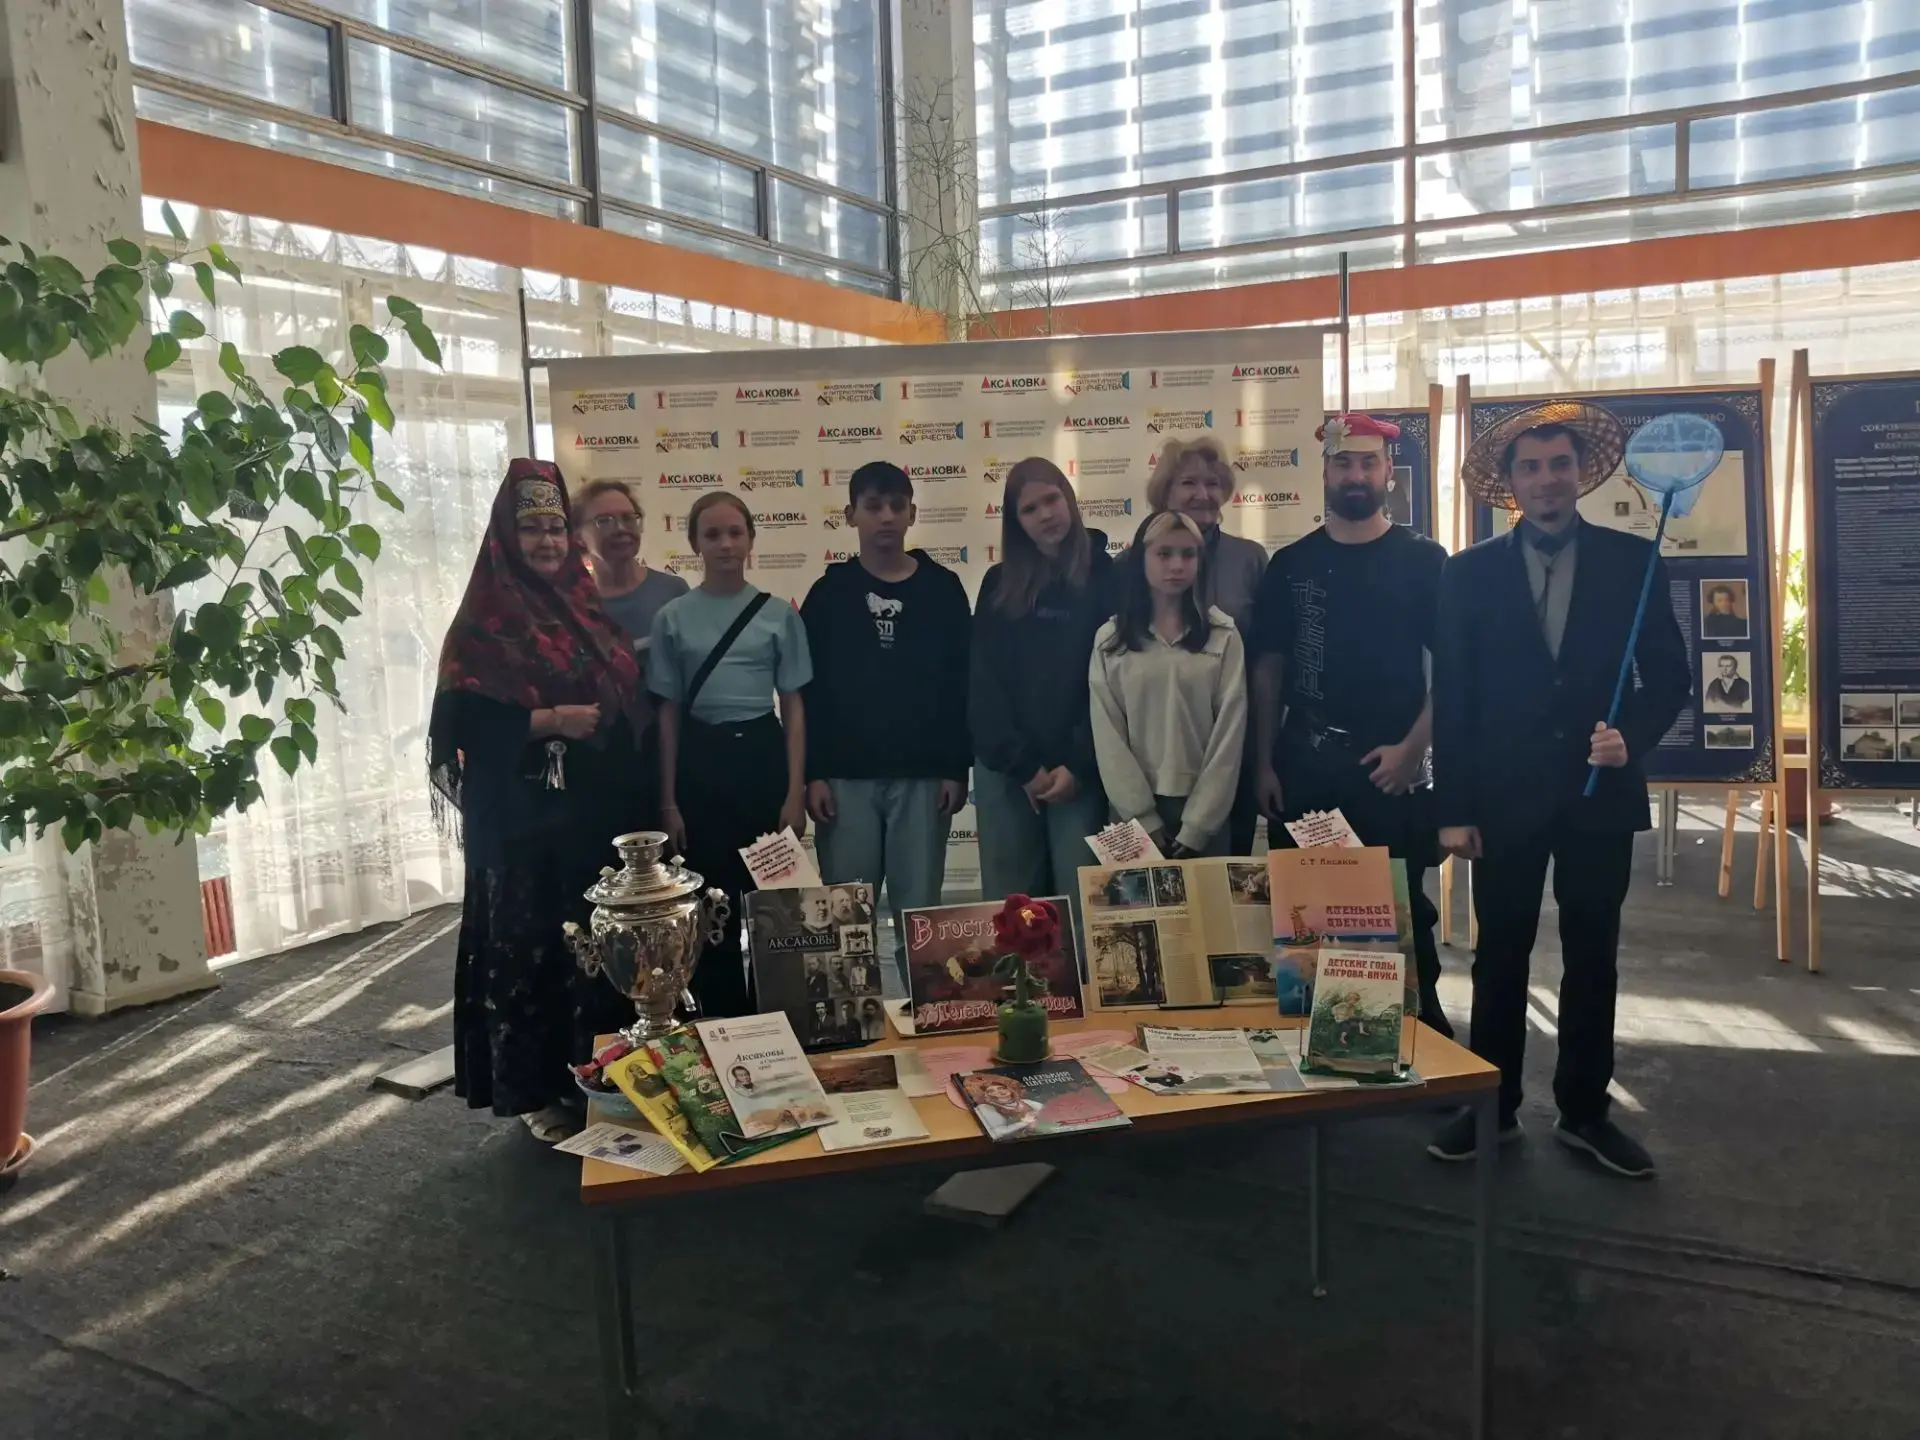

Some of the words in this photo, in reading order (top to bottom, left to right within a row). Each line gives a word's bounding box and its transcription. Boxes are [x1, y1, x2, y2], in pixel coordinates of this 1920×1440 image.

[752, 512, 807, 523] КСАКОВКА
[911, 914, 933, 951] В
[768, 934, 836, 949] АКСАКОВЫ
[1328, 958, 1367, 969] ДЕТСКИЕ
[1370, 961, 1396, 971] ГОДЫ
[1324, 968, 1398, 980] БАГРОВА-ВНУКА
[735, 1049, 785, 1063] Аксаковы
